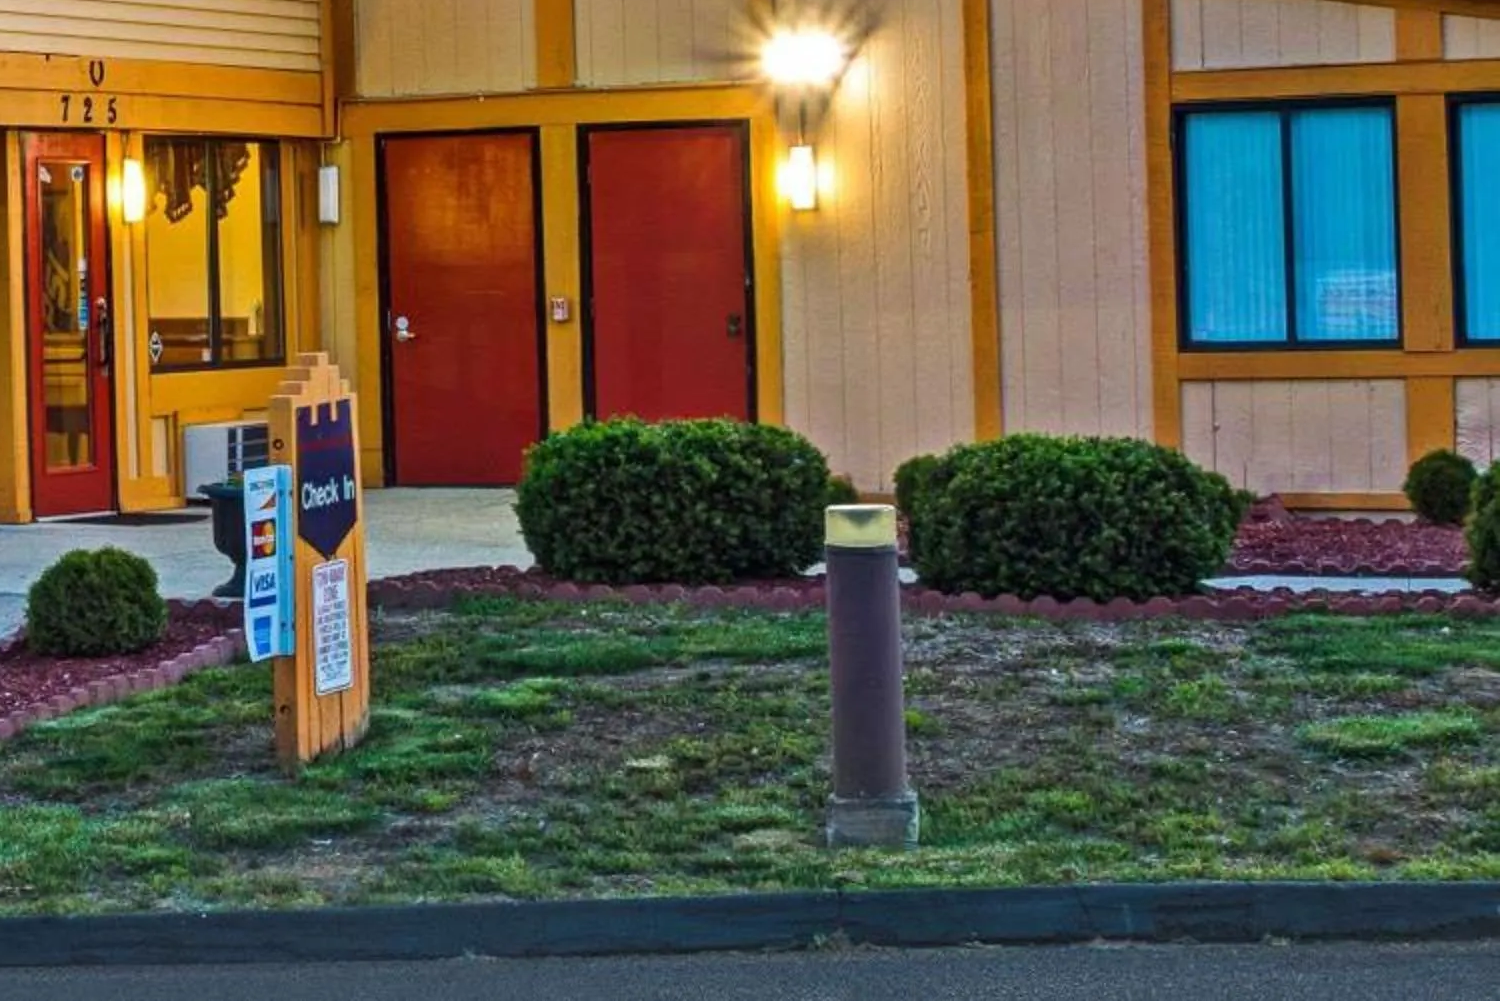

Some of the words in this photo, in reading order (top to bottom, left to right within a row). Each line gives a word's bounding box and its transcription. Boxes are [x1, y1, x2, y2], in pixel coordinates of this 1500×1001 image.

[61, 95, 117, 124] 725
[301, 476, 340, 511] Check
[343, 474, 355, 500] In
